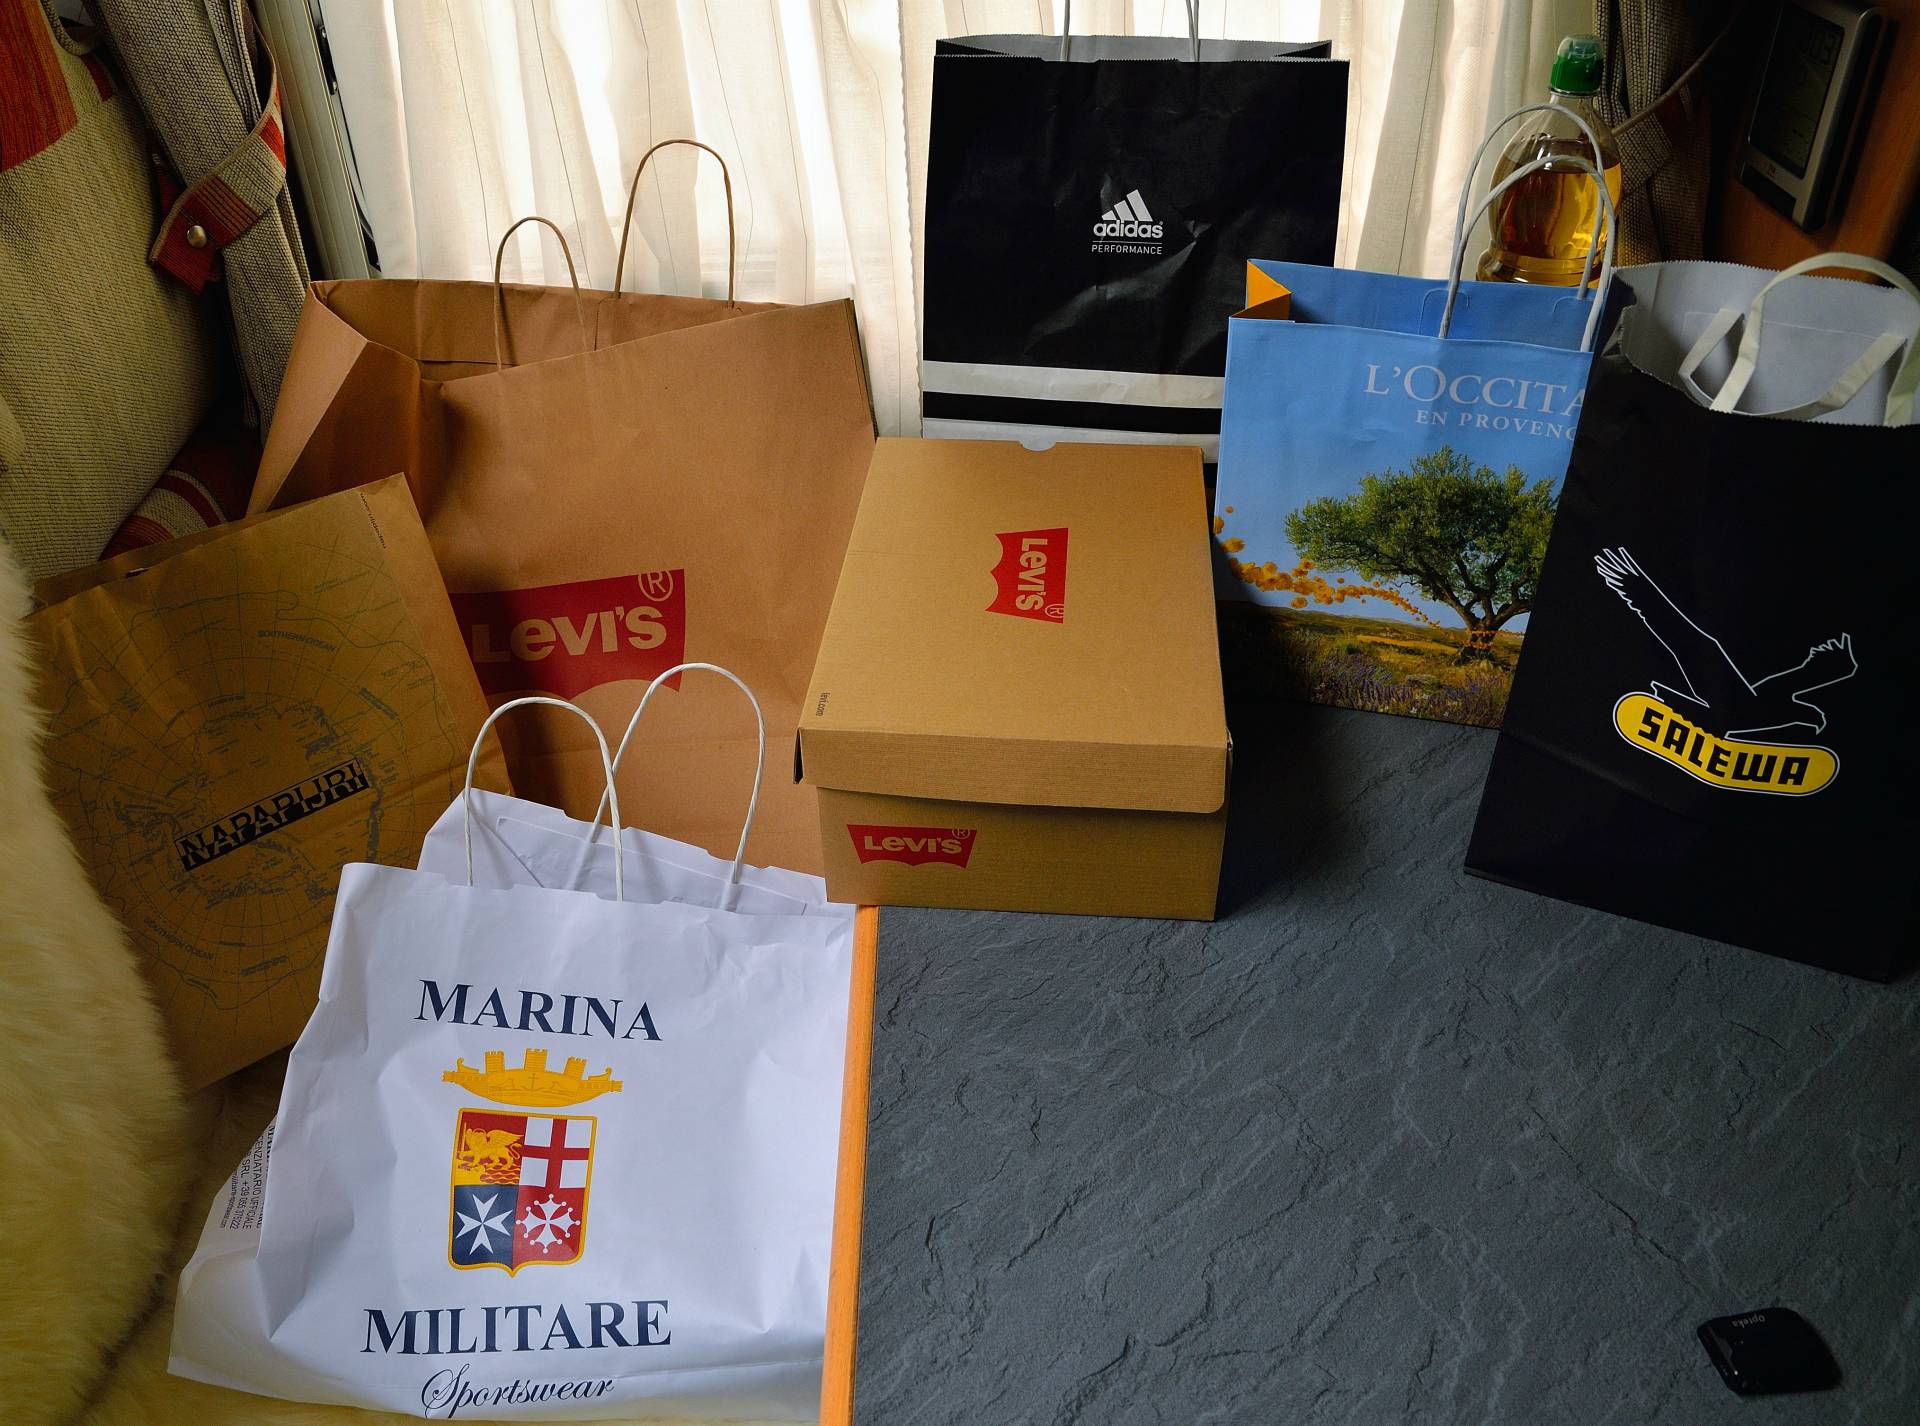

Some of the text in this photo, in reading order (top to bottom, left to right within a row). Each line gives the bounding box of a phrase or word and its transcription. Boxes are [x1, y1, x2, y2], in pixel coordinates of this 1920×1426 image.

[1091, 244, 1163, 255] PERFORMANCE
[1093, 219, 1164, 239] adidas
[1415, 409, 1448, 426] EN
[1015, 537, 1048, 611] Levi's
[471, 605, 668, 664] Levi's
[1637, 706, 1810, 786] SALEWA
[177, 761, 367, 868] NAPAPIJRI
[864, 834, 963, 854] Levi's
[413, 979, 663, 1042] MARINA
[241, 1158, 251, 1178] SRL
[360, 1299, 673, 1355] MILITARE
[421, 1362, 615, 1419] Sportswear
